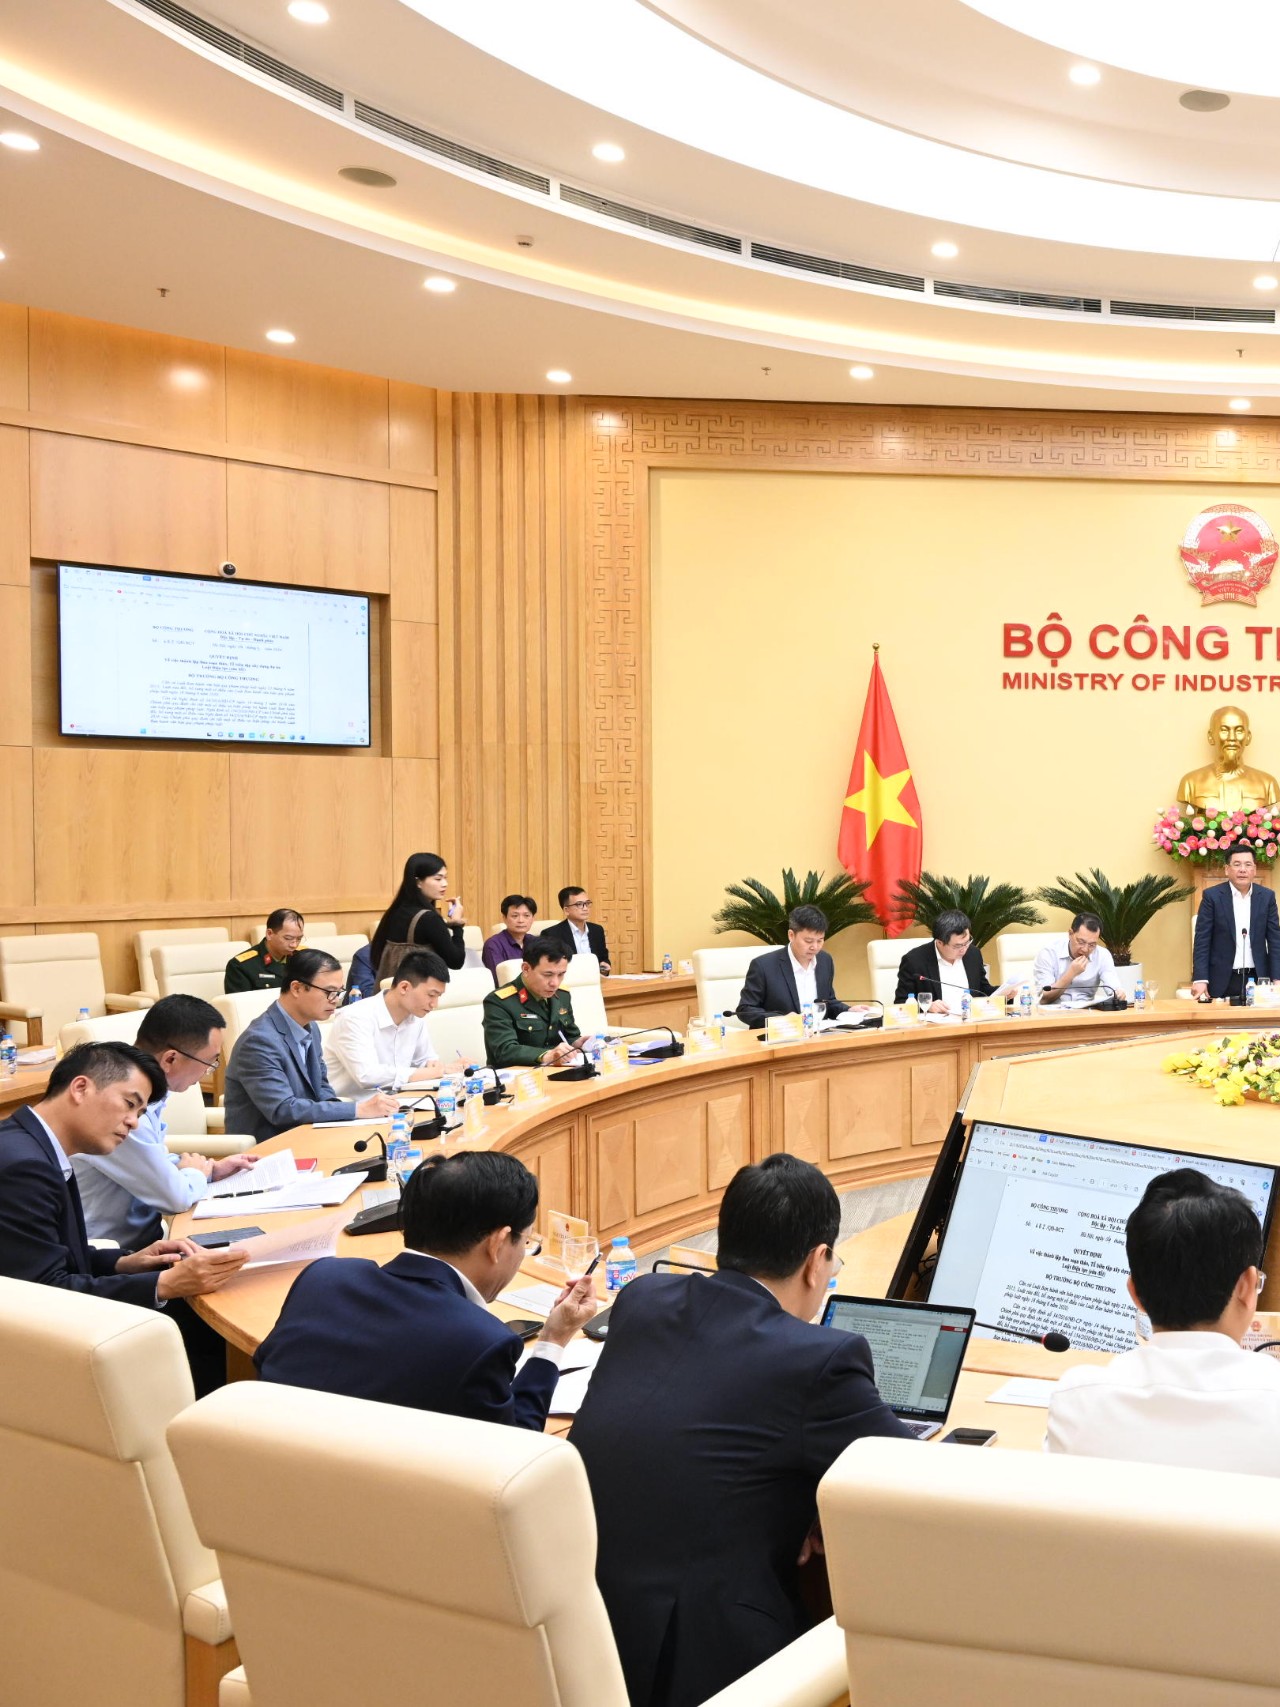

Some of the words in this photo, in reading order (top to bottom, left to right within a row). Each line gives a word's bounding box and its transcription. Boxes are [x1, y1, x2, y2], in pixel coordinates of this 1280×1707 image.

[1003, 612, 1072, 667] BỘ
[1089, 614, 1229, 660] CÔNG
[1002, 672, 1124, 690] MINISTRY
[1131, 673, 1166, 691] OF
